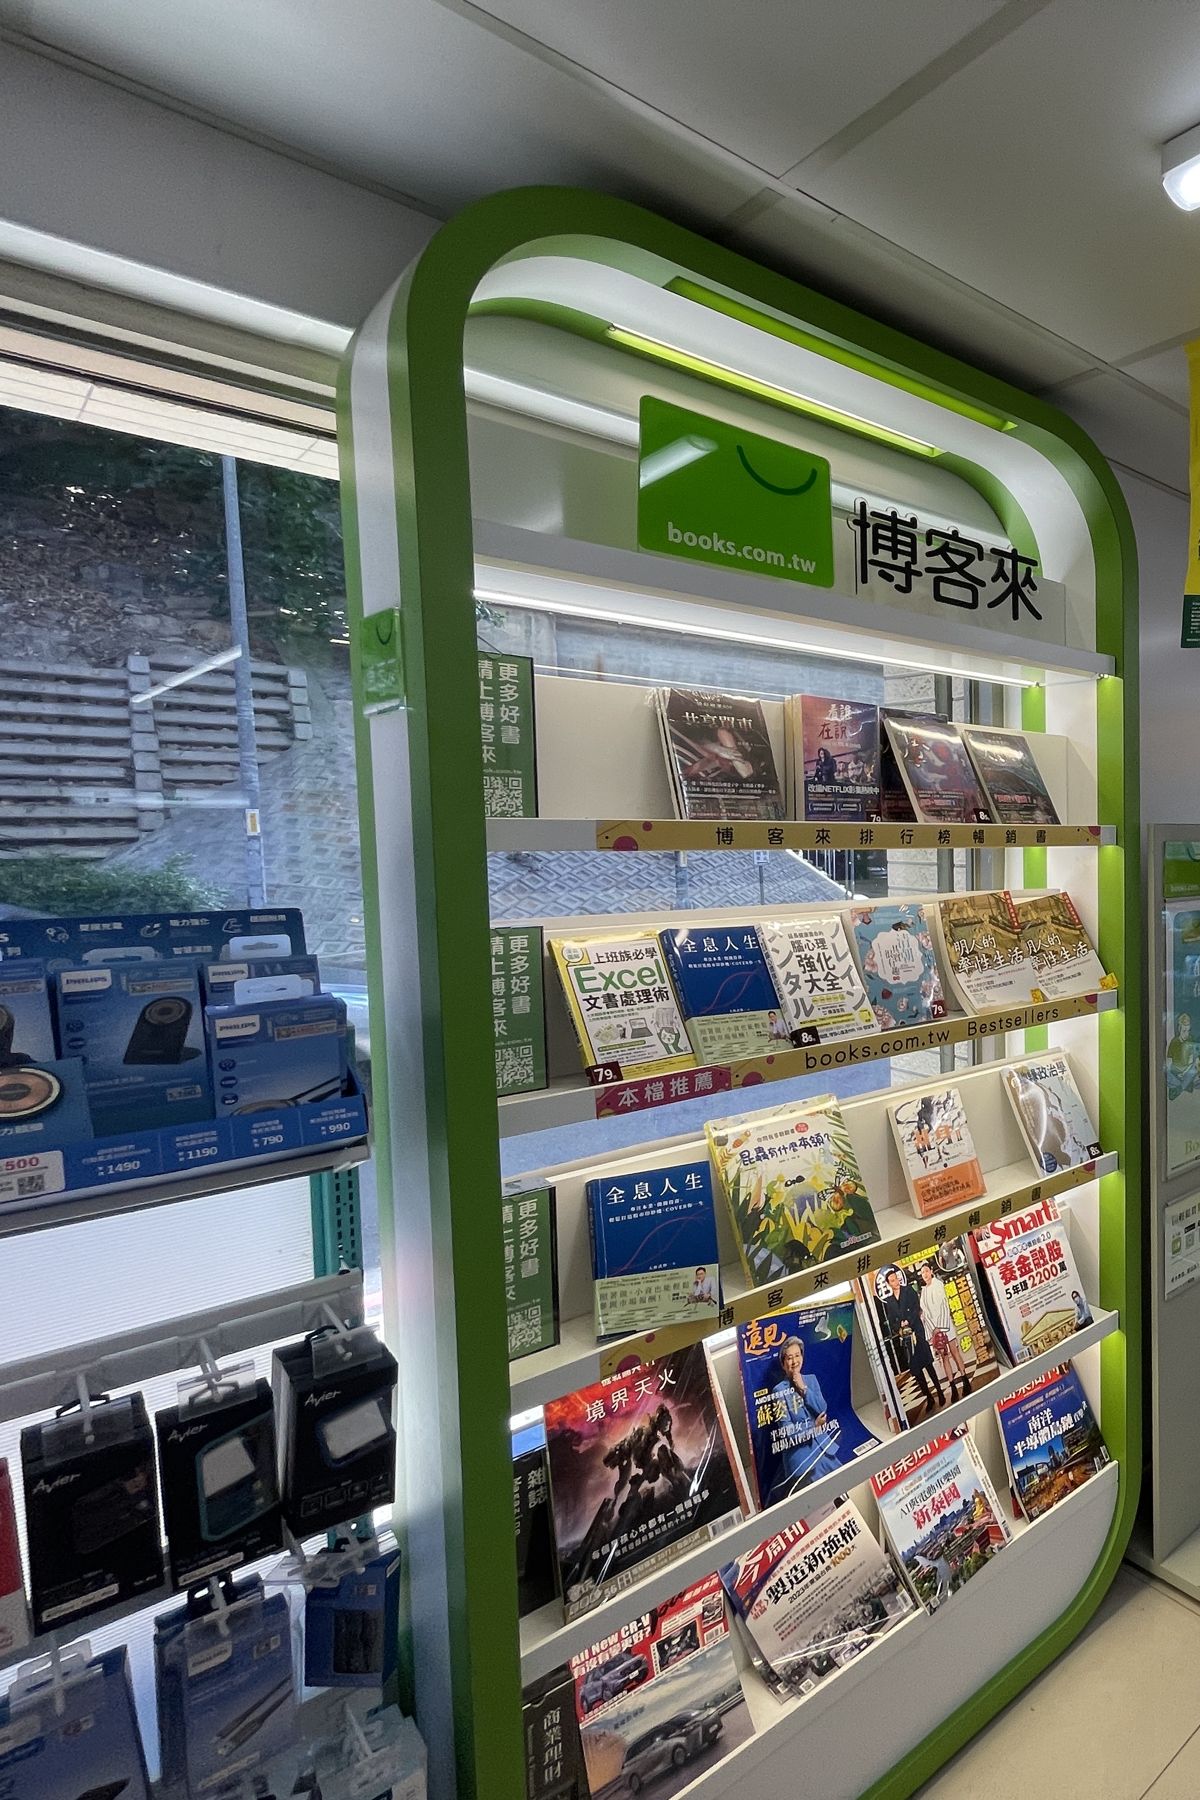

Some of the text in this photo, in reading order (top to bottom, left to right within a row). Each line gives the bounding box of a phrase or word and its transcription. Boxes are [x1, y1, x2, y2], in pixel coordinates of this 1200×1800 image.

[667, 521, 818, 574] books.com.tw
[854, 500, 1043, 622] 博客來
[498, 662, 521, 745] 更多好書
[716, 826, 1047, 846] 博客來排行榜暢銷書
[593, 947, 658, 964] 上班族必學
[682, 935, 760, 953] 全息人生
[790, 938, 829, 953] 腦心理
[953, 934, 997, 956] 明人的
[508, 935, 531, 1014] 更多好書
[573, 959, 666, 993] Excel
[795, 952, 836, 974] 強化
[957, 946, 1024, 976] 率性生活
[582, 987, 670, 1011] 文書處理術
[804, 972, 843, 994] 大全
[805, 1006, 1060, 1070] books.com.tw Bestsellers
[617, 1071, 714, 1108] 本檔推薦
[262, 1134, 284, 1145] 790
[329, 1122, 351, 1133] 990
[106, 1160, 140, 1174] 1490
[187, 1146, 218, 1159] 1190
[606, 1173, 703, 1205] 全息人生
[518, 1199, 540, 1278] 更多好書
[989, 1200, 1053, 1245] Smart
[997, 1239, 1064, 1286] 養金融股
[742, 1319, 787, 1356] 遠見
[586, 1368, 677, 1423] 境界天火
[1027, 1407, 1053, 1434] 南洋
[527, 1466, 548, 1509] 雜誌
[912, 1481, 961, 1531] 新泰國
[734, 1520, 806, 1590] 今周刊
[765, 1516, 862, 1606] 製造新強權
[620, 1613, 651, 1639] CR-V
